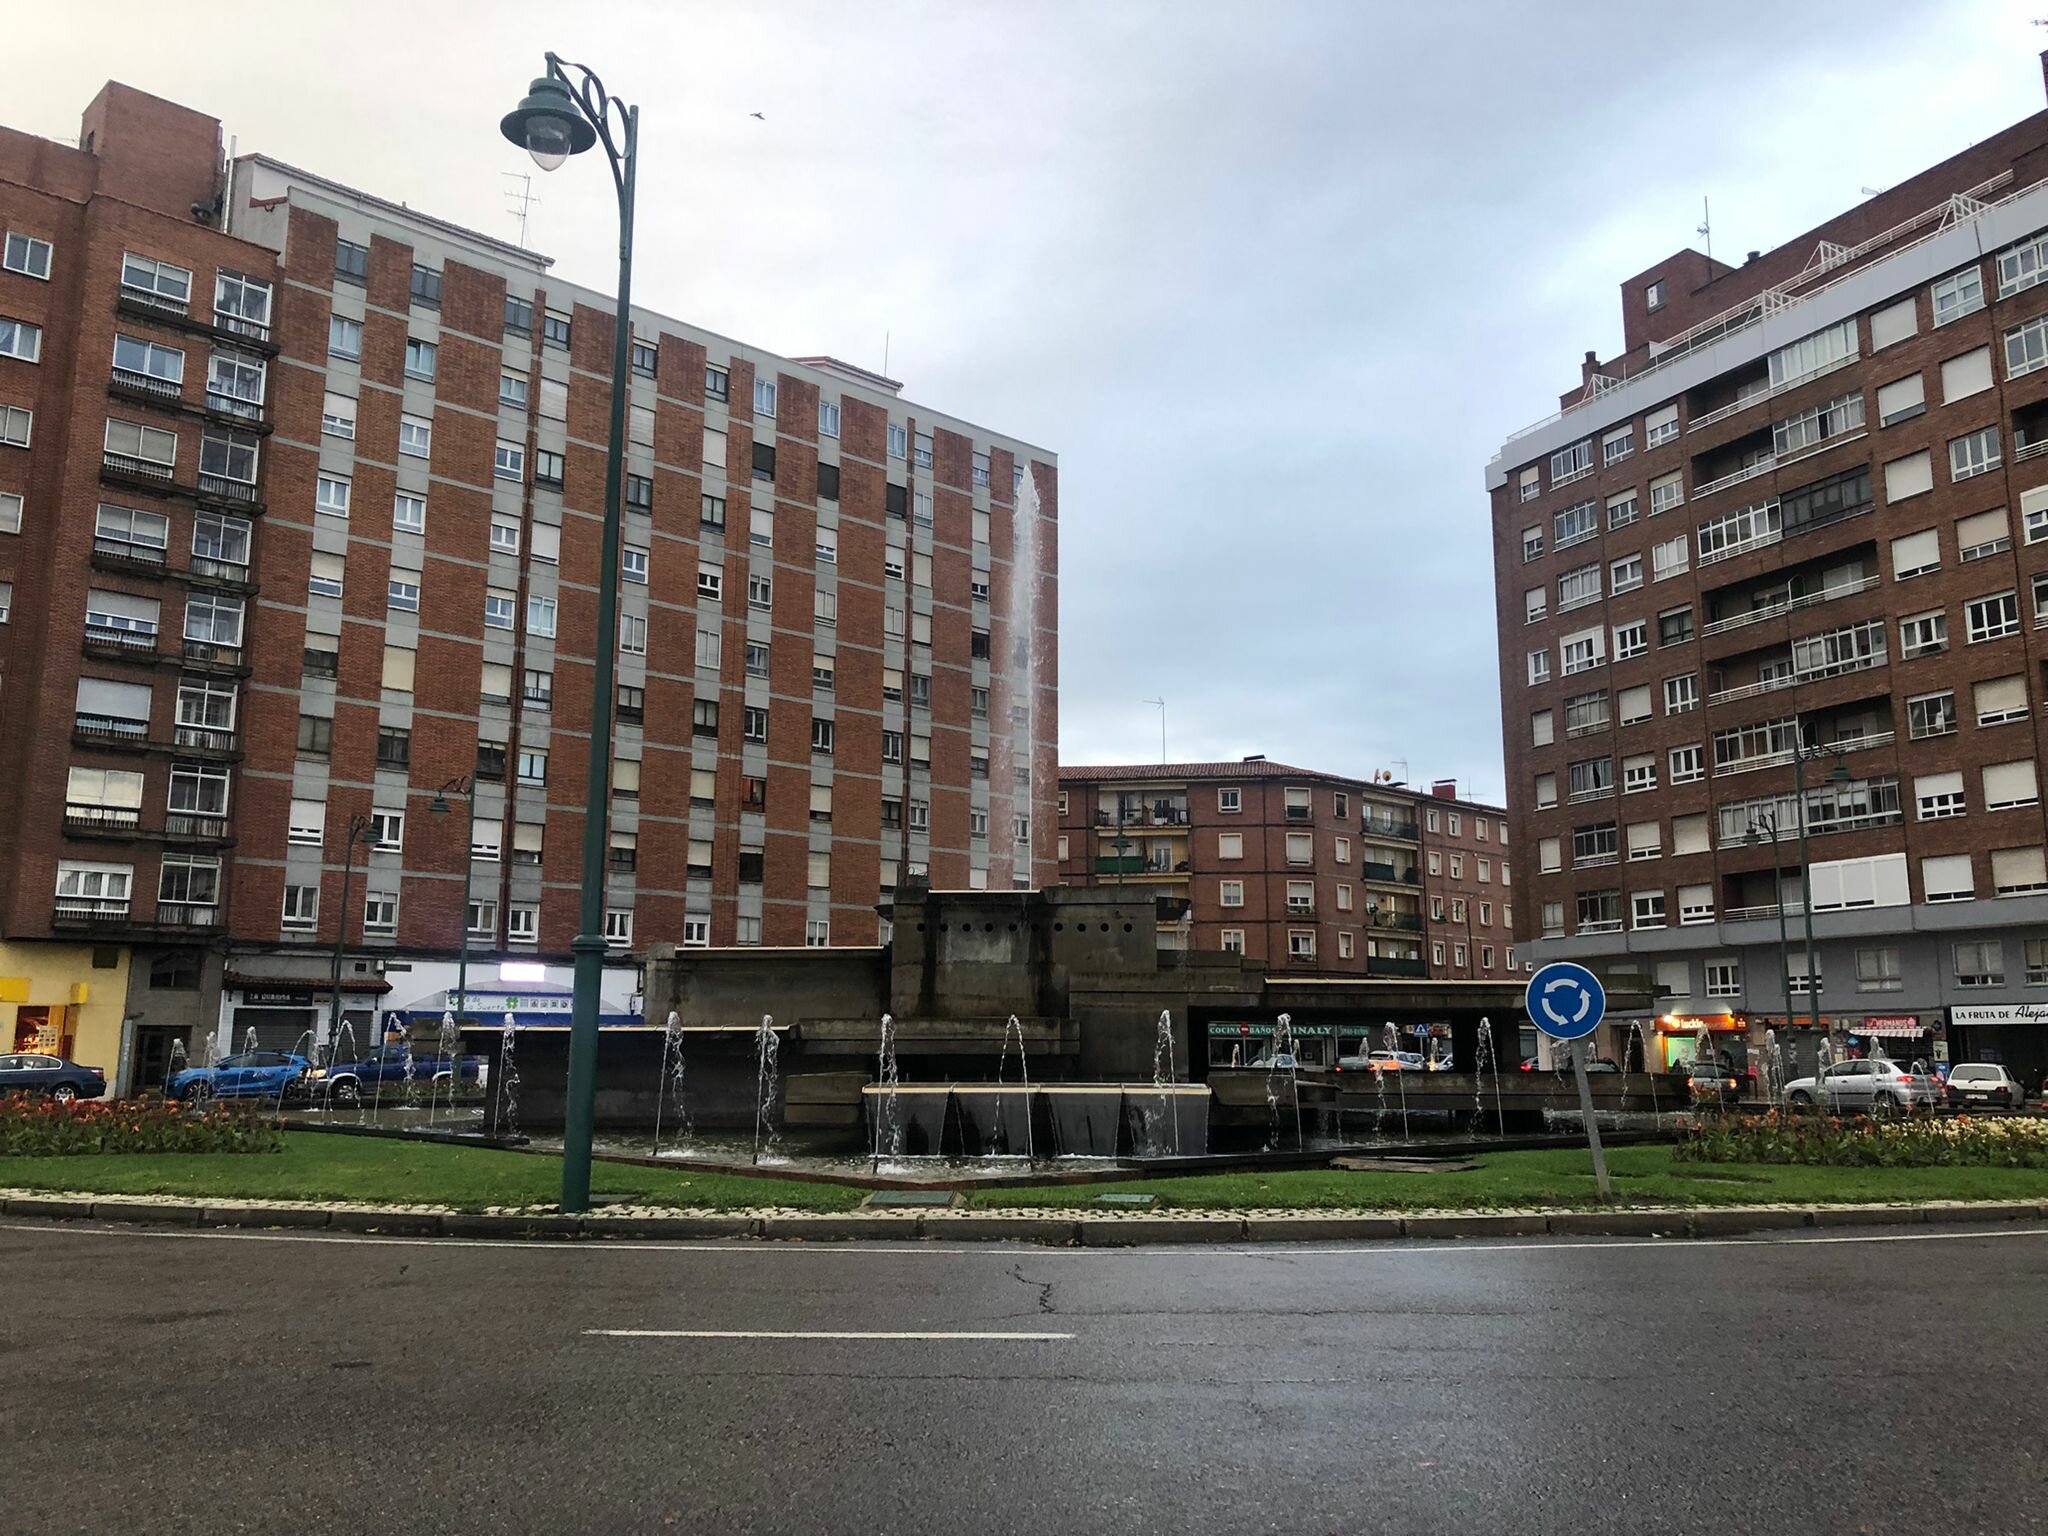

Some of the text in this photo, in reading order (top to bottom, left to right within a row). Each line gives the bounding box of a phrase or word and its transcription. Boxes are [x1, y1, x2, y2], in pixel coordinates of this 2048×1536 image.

[1955, 1005, 2048, 1022] LA FRUTA DE Aleja
